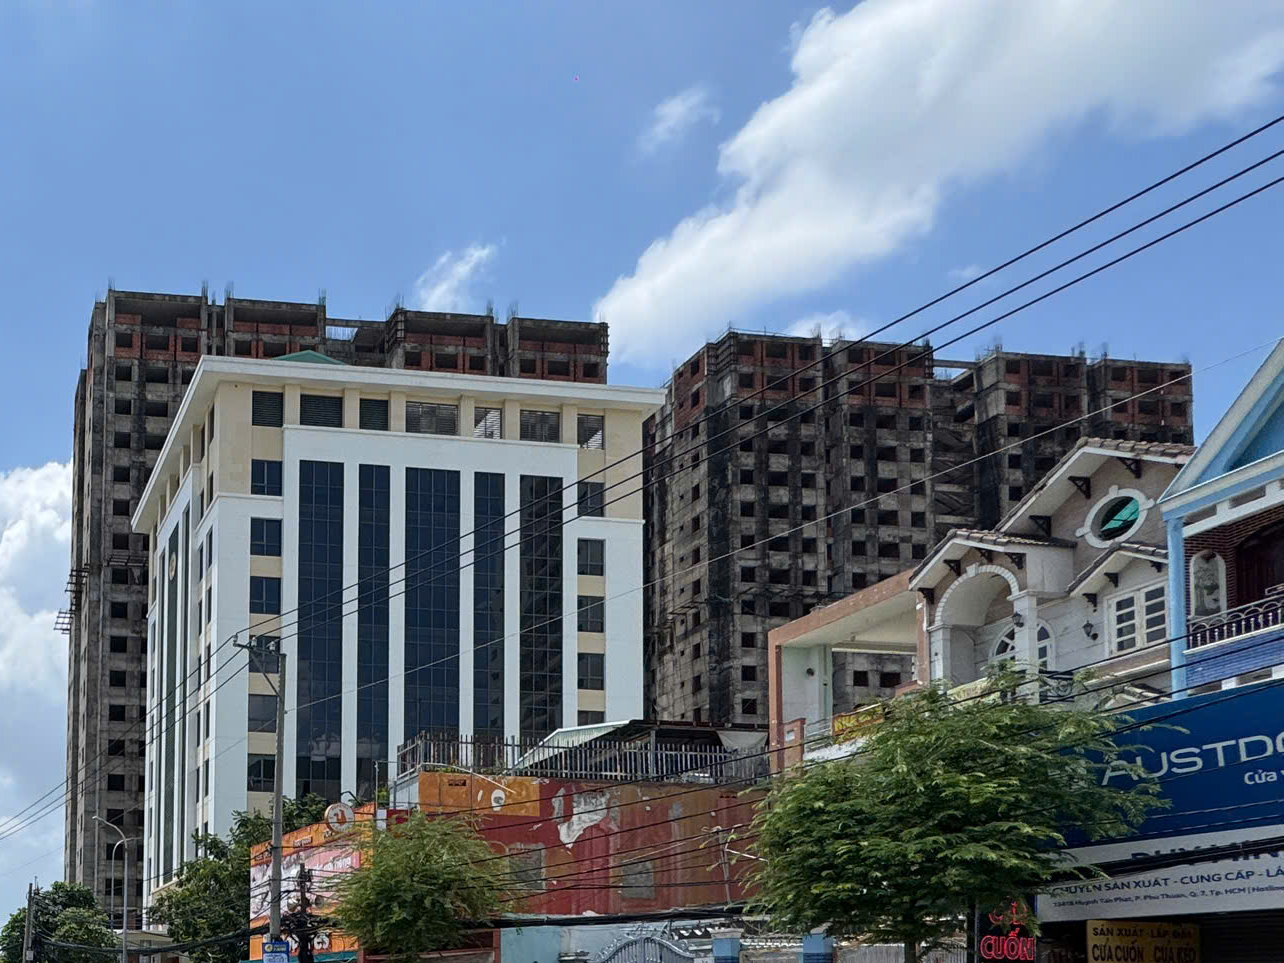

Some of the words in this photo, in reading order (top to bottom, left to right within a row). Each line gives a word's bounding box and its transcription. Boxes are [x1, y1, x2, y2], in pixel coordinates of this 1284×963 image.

[1101, 731, 1284, 787] AUSTD
[1243, 768, 1277, 785] Cửa
[1133, 875, 1171, 889] XUẤT
[1180, 873, 1221, 885] CUNG
[1224, 868, 1254, 882] CẤP
[1224, 886, 1246, 895] HCM
[1092, 924, 1114, 937] SẢN
[1117, 924, 1144, 938] XUẤT
[980, 927, 1035, 961] CUỐN
[1092, 937, 1114, 962] CỬA
[1115, 938, 1145, 963] CUỐN
[1154, 939, 1176, 963] CỬA
